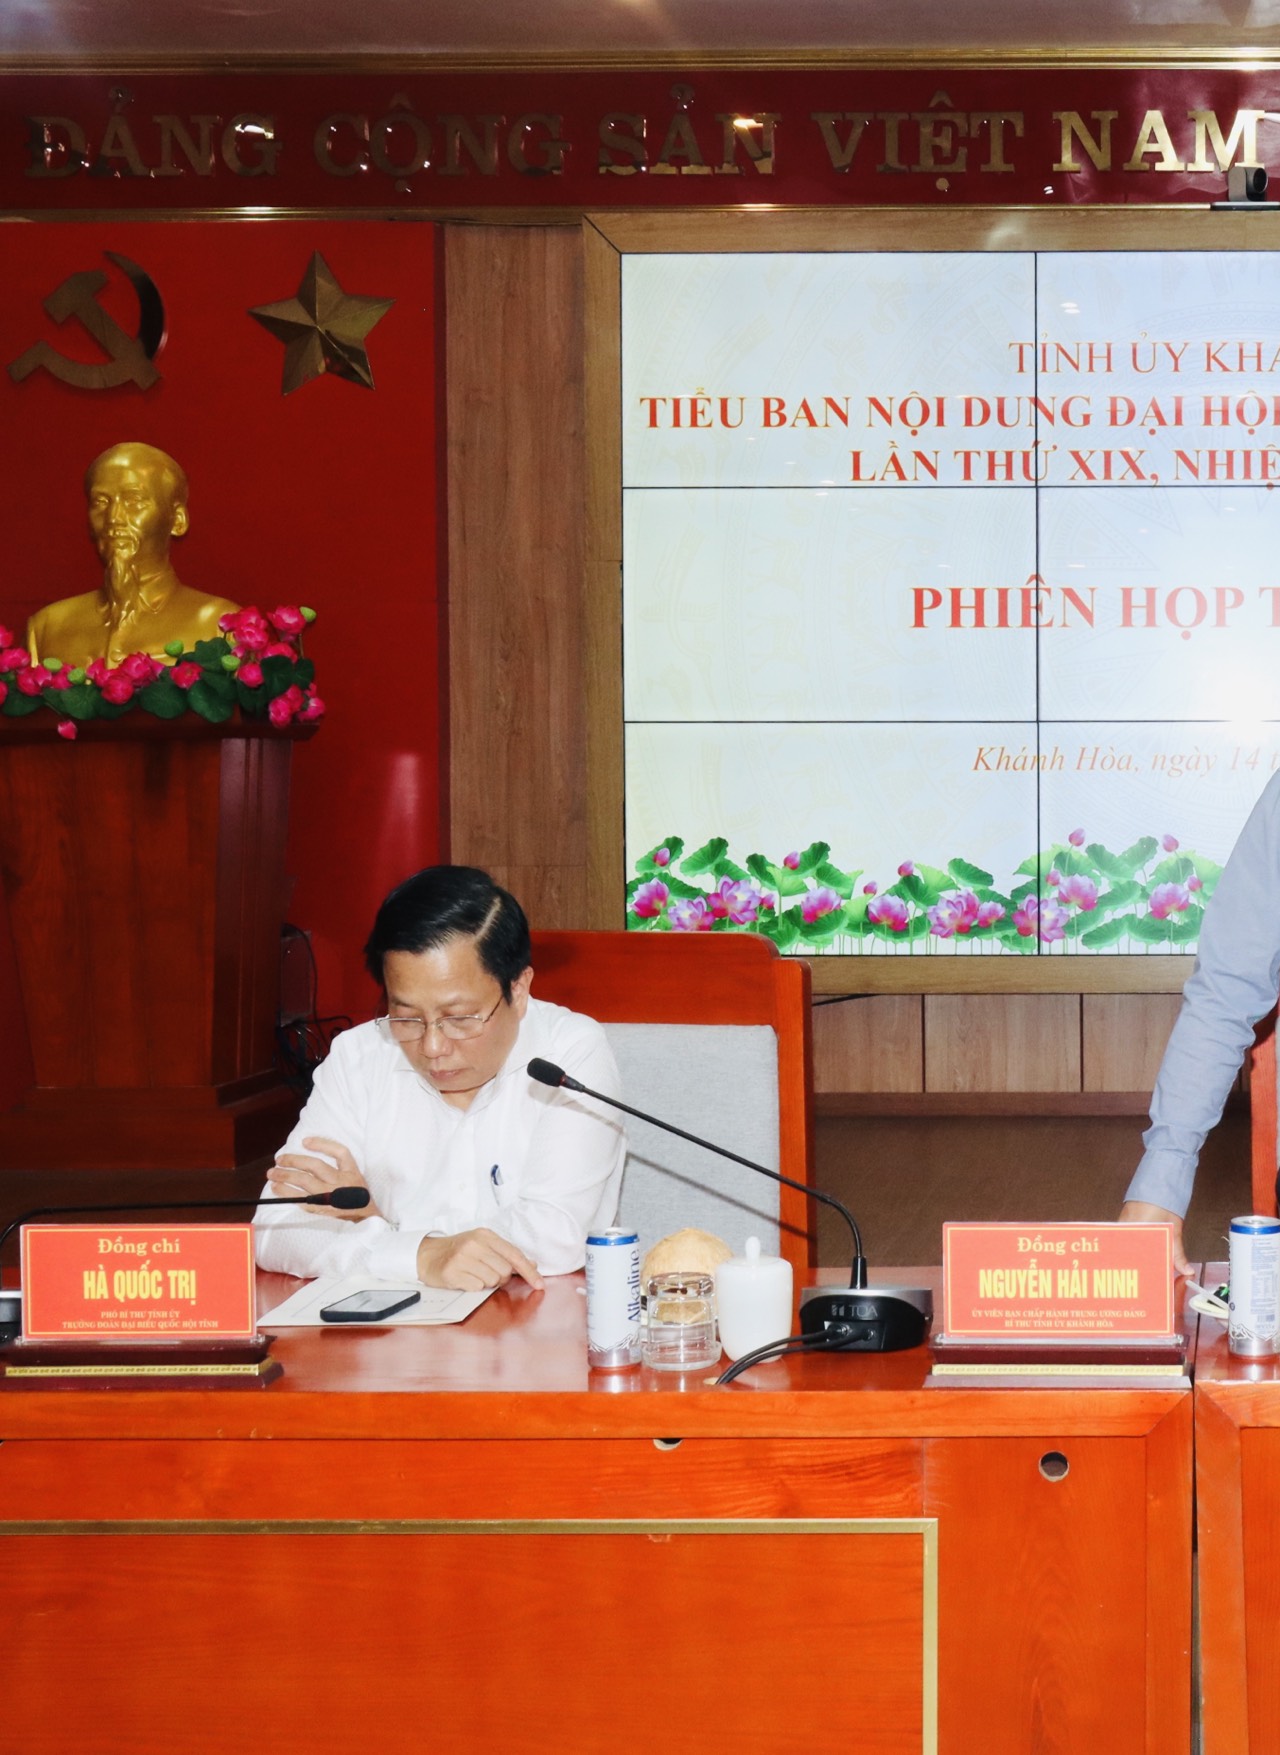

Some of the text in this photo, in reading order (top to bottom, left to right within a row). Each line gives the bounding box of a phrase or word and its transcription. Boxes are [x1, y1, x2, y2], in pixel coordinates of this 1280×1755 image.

[23, 87, 284, 178] ĐẢNG
[313, 93, 573, 194] CỘNG
[598, 85, 783, 176] SẢN
[811, 90, 1024, 190] VIỆT
[1052, 109, 1264, 172] NAM
[1009, 332, 1113, 374] TỈNH
[1130, 331, 1190, 374] ỦY
[640, 387, 746, 429] TIỂU
[762, 396, 851, 429] BAN
[867, 391, 946, 437] NỘI
[963, 396, 1092, 429] DUNG
[1107, 396, 1184, 436] ĐẠI
[850, 441, 939, 483] LẦN
[954, 440, 1057, 482] THỨ
[1069, 450, 1159, 487] XIX,
[909, 574, 1096, 629] PHIÊN
[1120, 586, 1244, 640] HỌP
[972, 746, 1065, 772] Khánh
[1075, 745, 1140, 773] Hòa,
[1151, 748, 1217, 778] ngày
[1230, 746, 1261, 771] 14
[98, 1236, 180, 1256] Đồng chí
[1017, 1235, 1100, 1256] Đồng chí
[83, 1260, 196, 1305] HÀ QUỐC TRỊ
[627, 1248, 640, 1323] Alkaline
[979, 1259, 1139, 1299] NGUYỄN HẢI NINH
[849, 1304, 878, 1318] TOA
